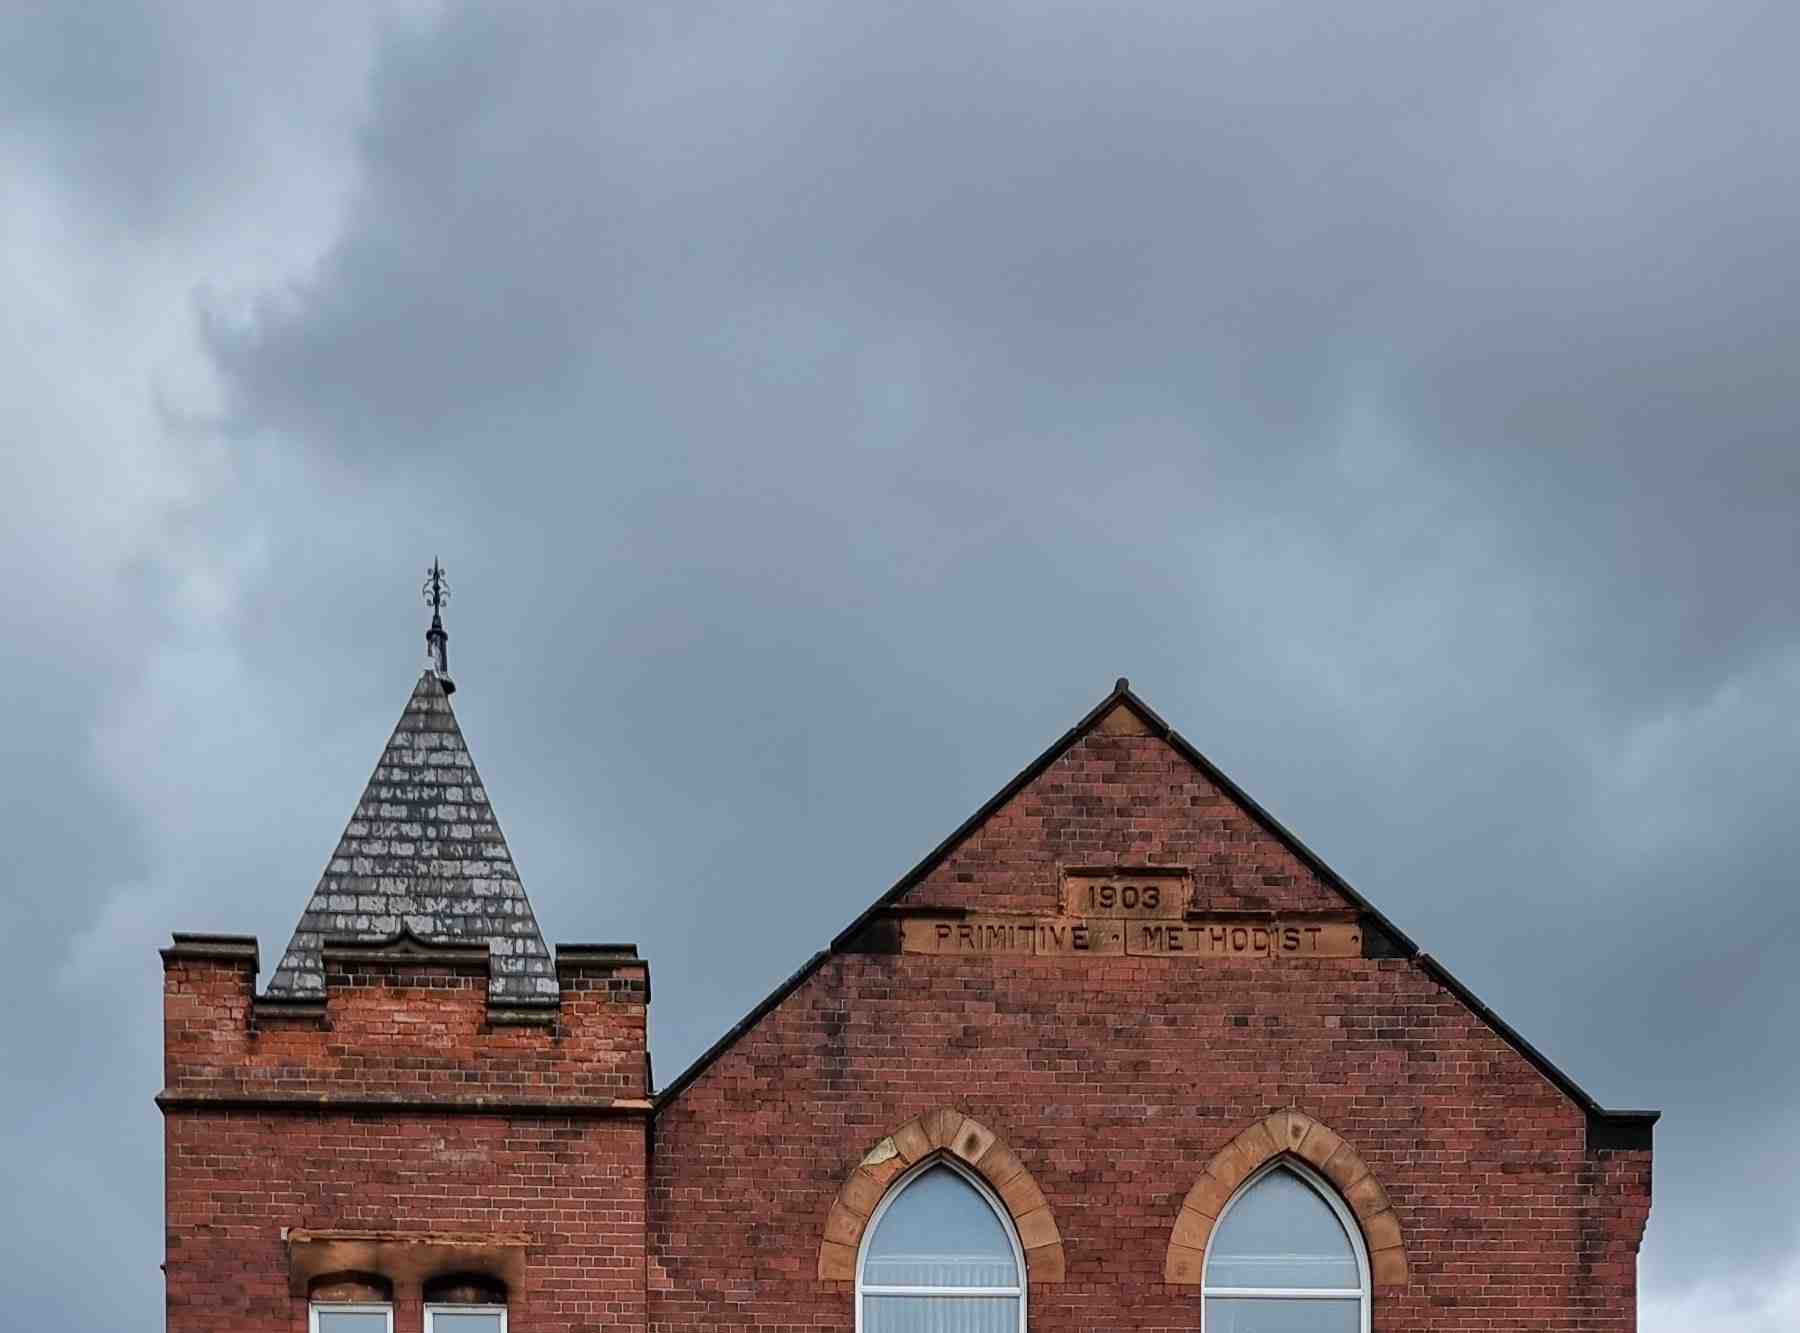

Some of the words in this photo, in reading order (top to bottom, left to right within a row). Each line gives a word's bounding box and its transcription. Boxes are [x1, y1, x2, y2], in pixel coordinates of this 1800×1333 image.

[1087, 885, 1161, 909] 1903
[934, 923, 1089, 951] PRIMITIVE
[1142, 924, 1323, 953] METHODIST
